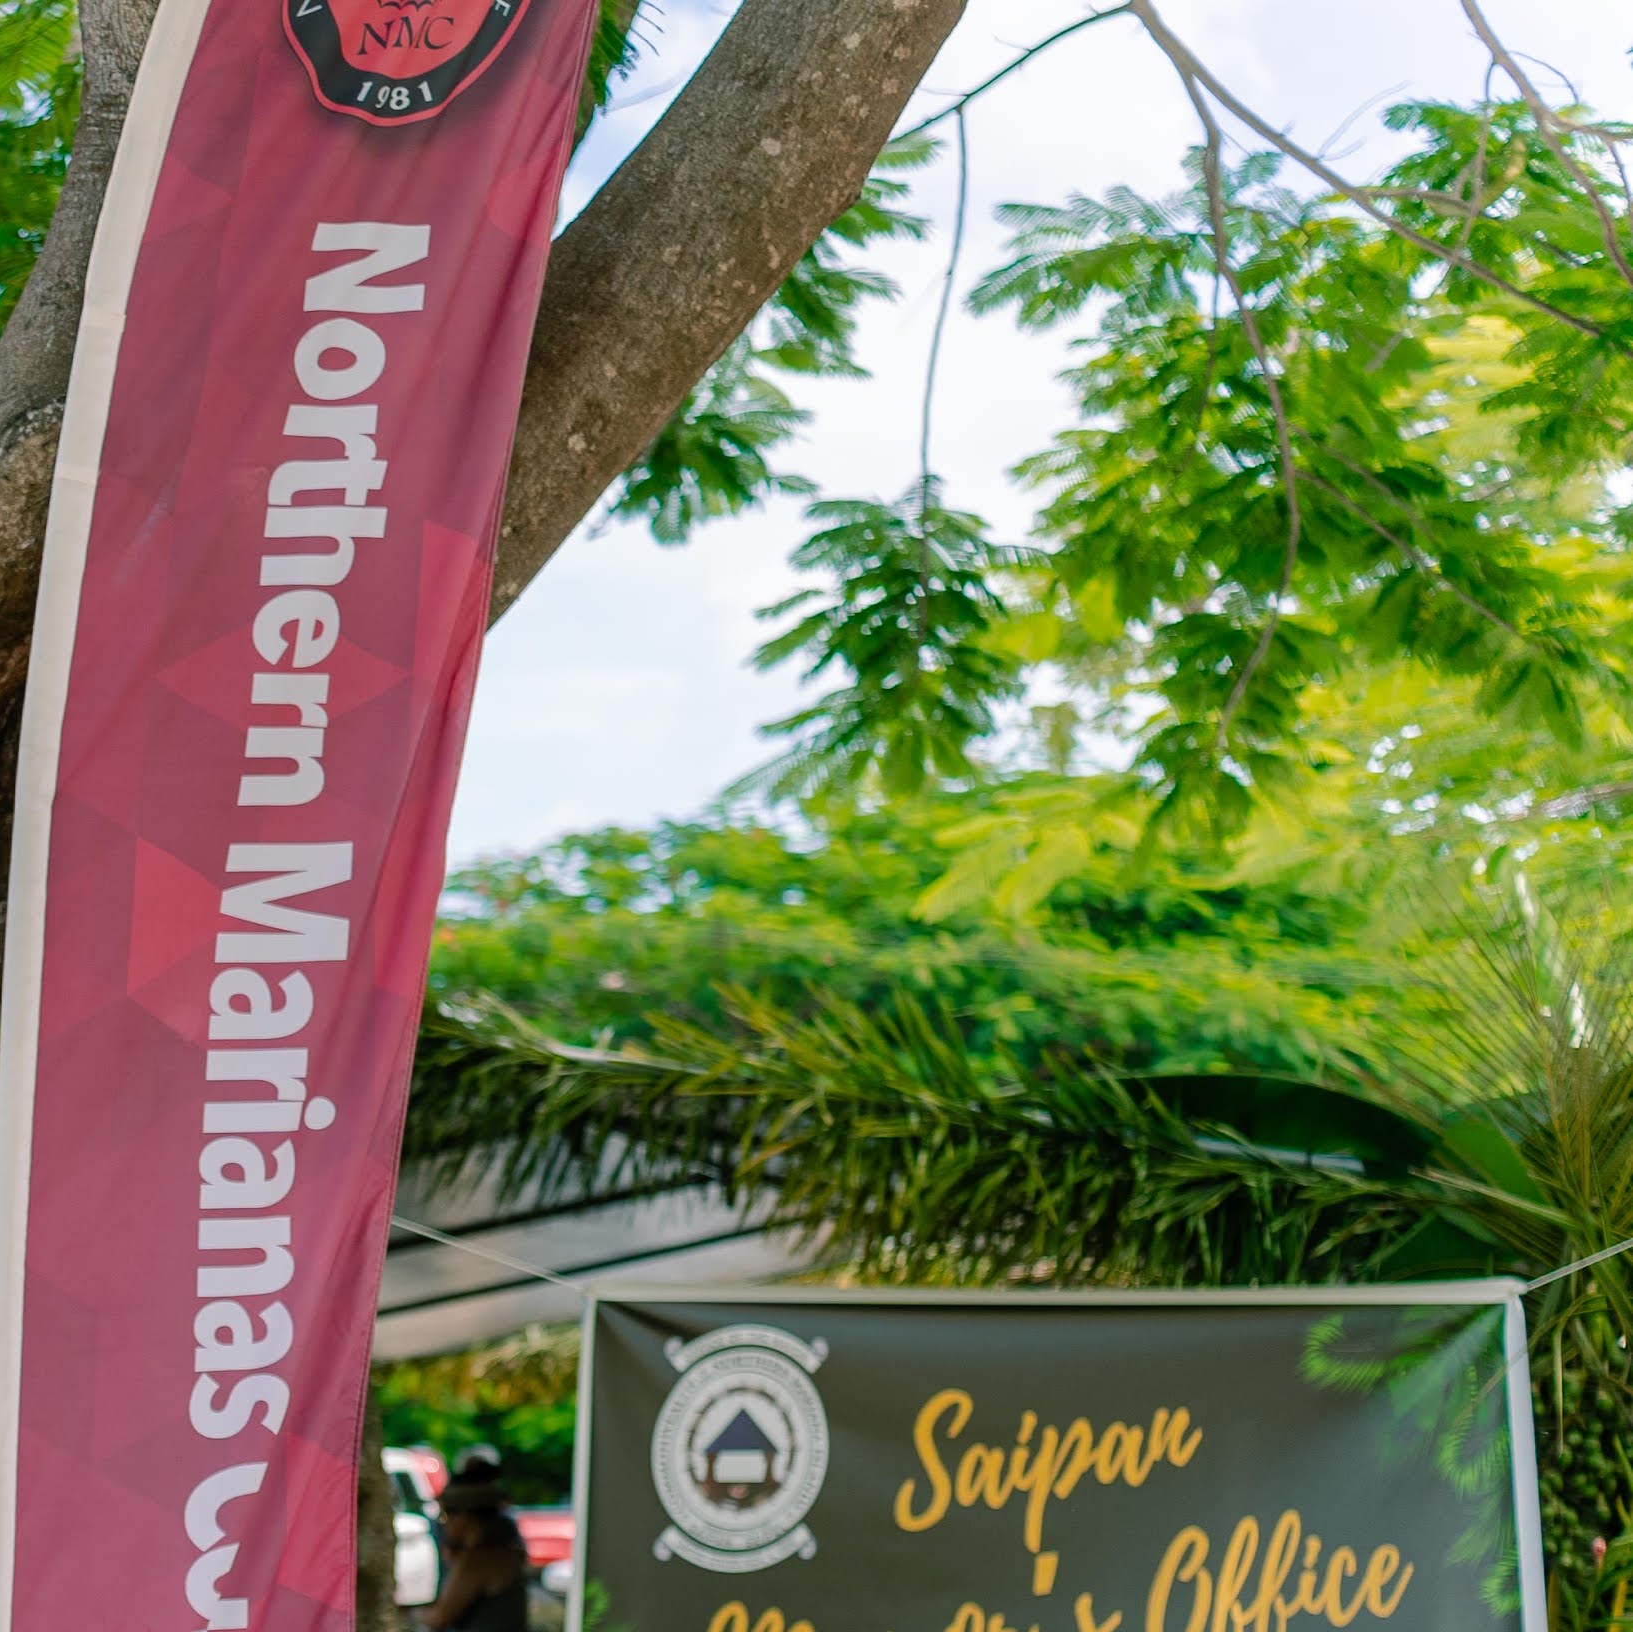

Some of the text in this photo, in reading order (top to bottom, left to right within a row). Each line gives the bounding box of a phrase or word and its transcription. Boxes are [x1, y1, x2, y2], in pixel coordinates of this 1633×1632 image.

[355, 80, 433, 111] 1981
[356, 15, 455, 56] NMC
[237, 218, 433, 810] Northern
[186, 838, 355, 1442] Marianas
[893, 1386, 1204, 1554] Saipan
